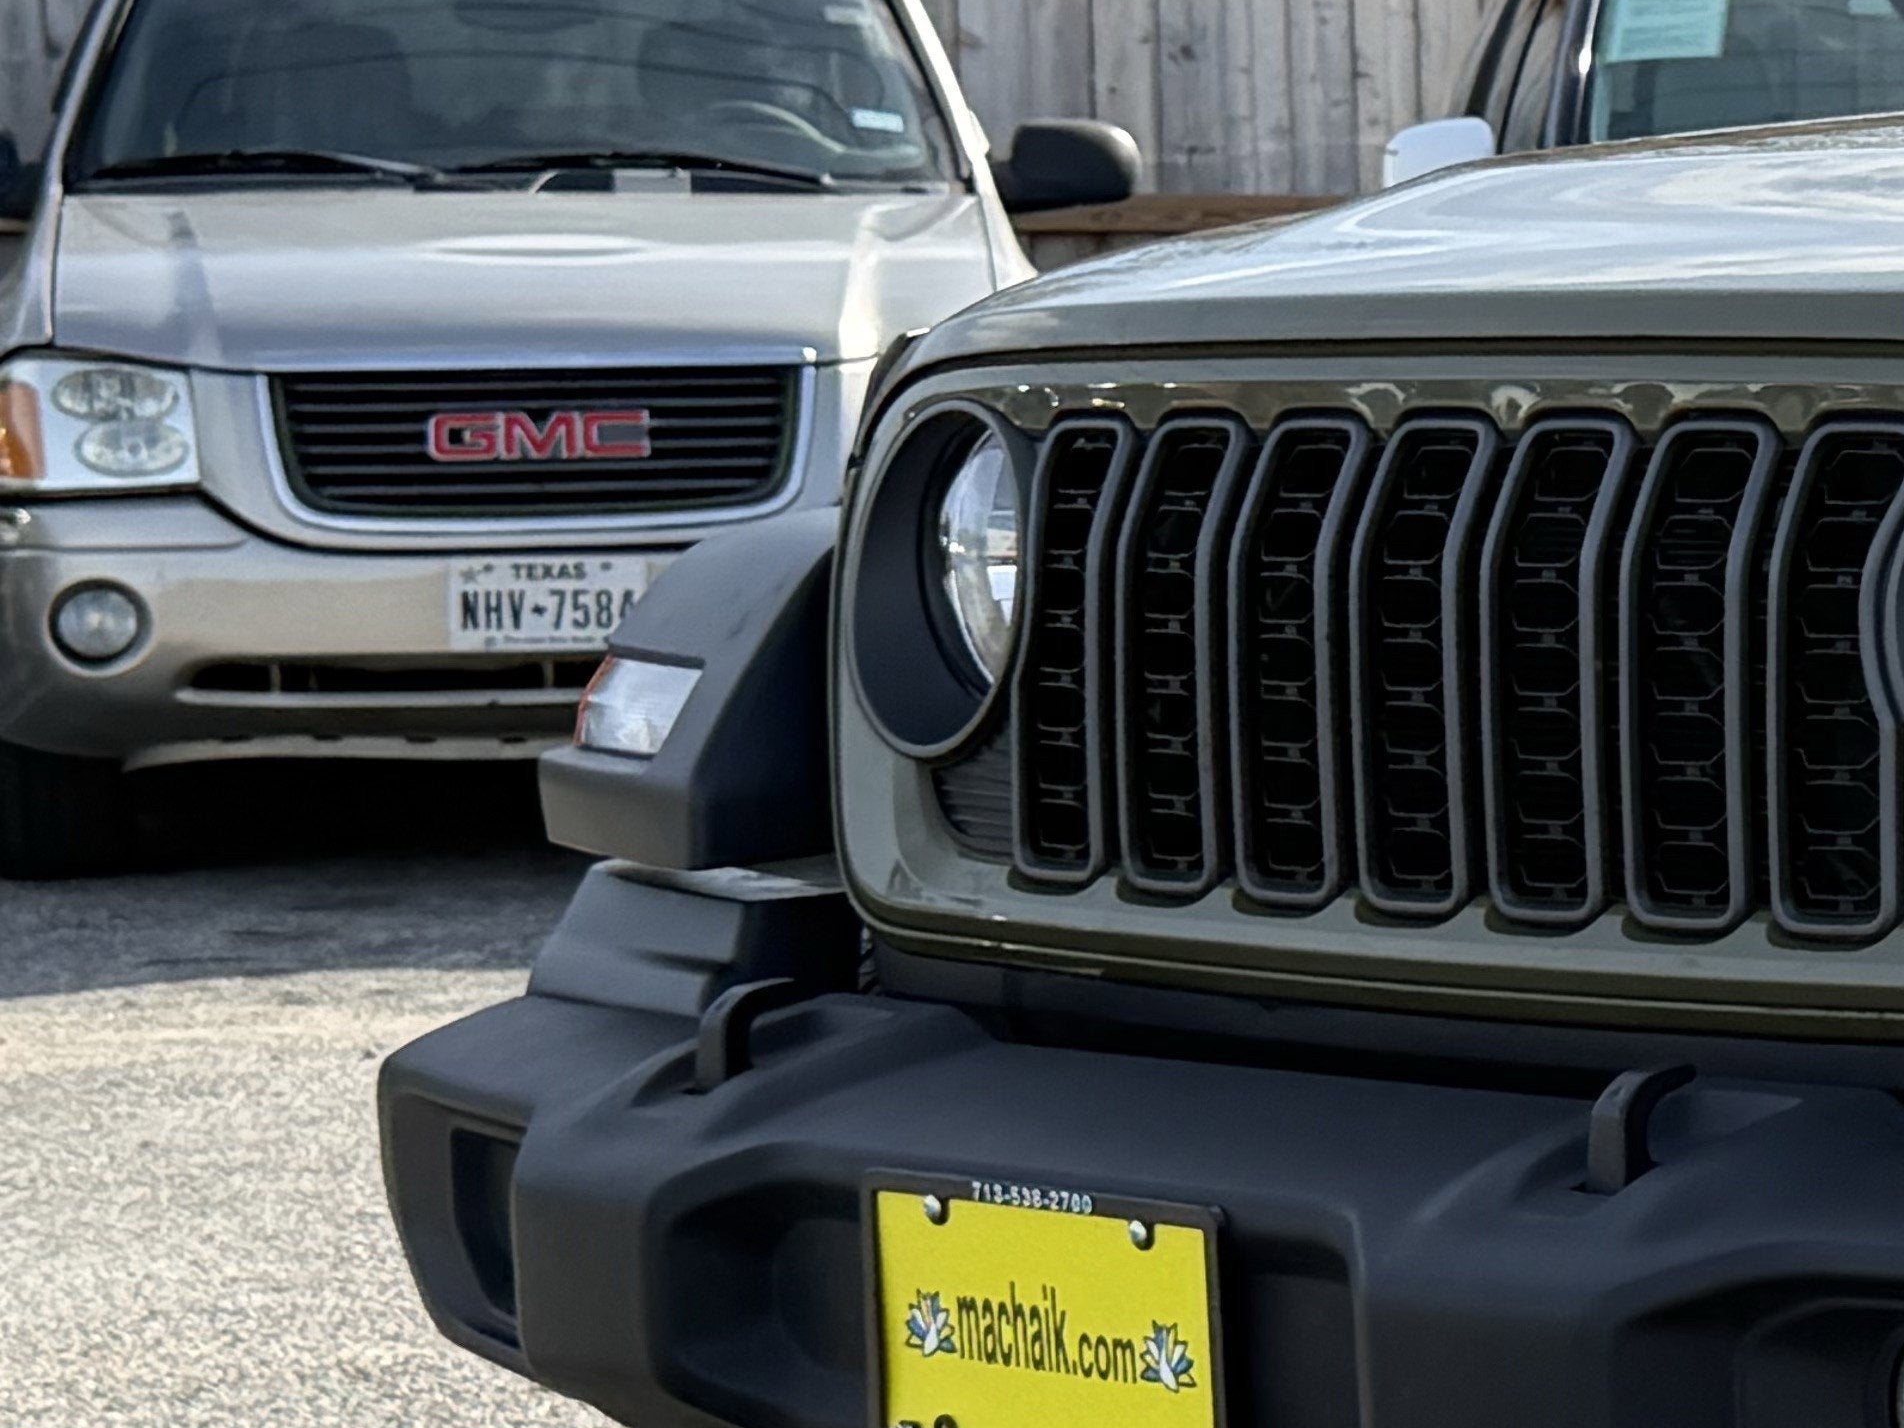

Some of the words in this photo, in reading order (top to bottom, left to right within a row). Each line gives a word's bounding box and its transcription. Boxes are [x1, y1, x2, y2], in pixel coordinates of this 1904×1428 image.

[429, 409, 651, 462] GMC
[511, 561, 587, 581] TEXAS
[972, 1180, 1093, 1215] 713-538-2700
[956, 1280, 1138, 1385] machaik.com
